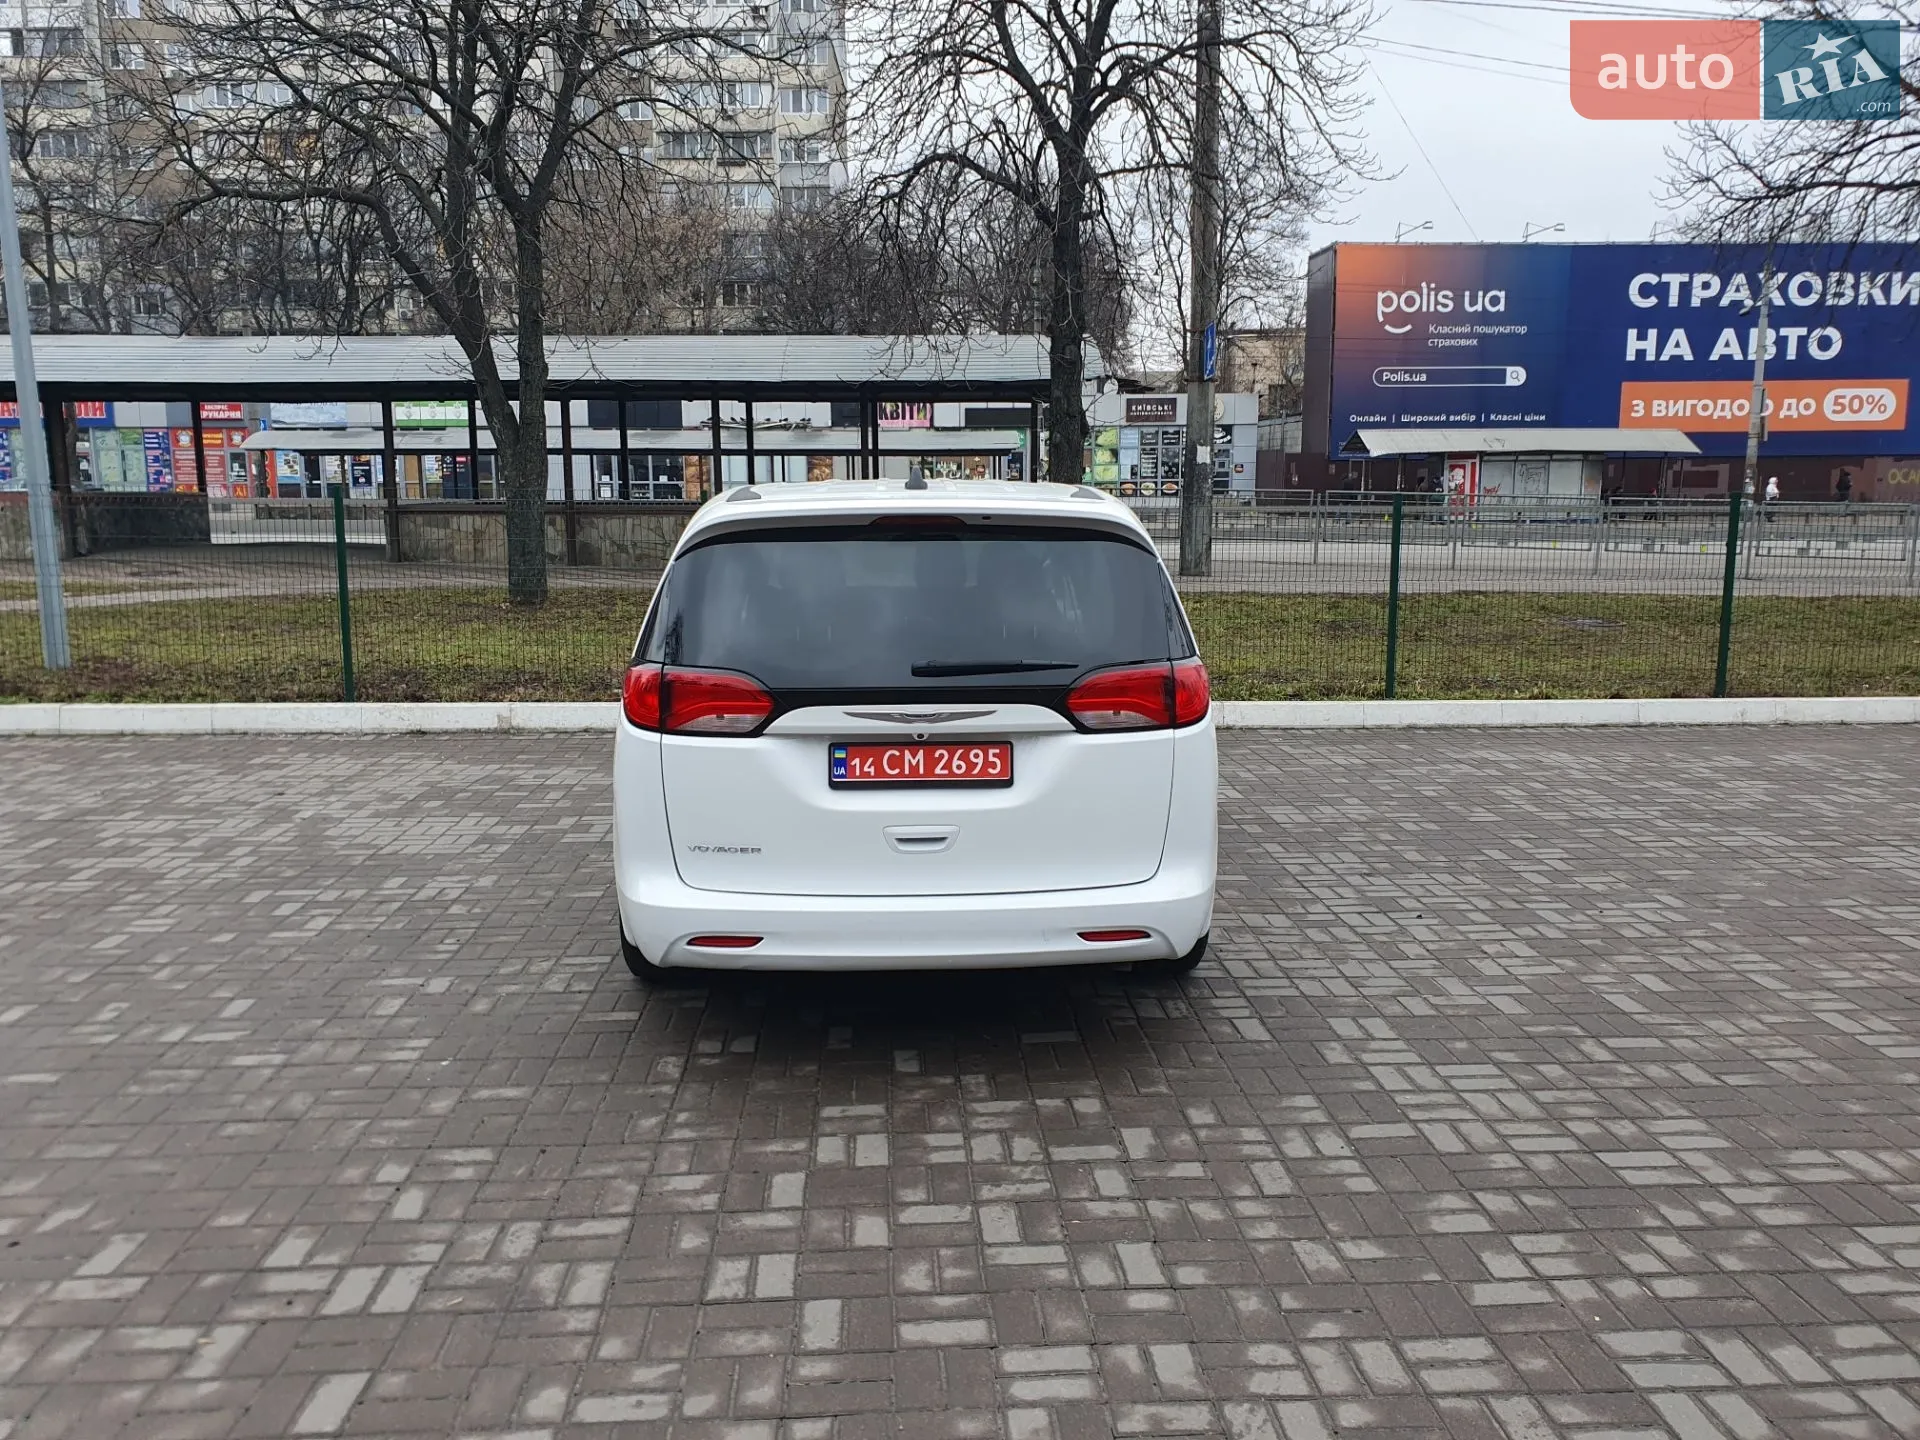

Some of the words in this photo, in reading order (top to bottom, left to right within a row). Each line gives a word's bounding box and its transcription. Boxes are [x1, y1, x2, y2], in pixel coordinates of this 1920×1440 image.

[1628, 271, 1920, 308] СТРАХОВКИ
[1376, 281, 1454, 322] polis
[1464, 290, 1506, 312] ua
[1428, 324, 1471, 334] Класний
[1473, 325, 1527, 335] пошукатор
[1428, 338, 1478, 348] страхових
[1626, 328, 1694, 361] НА
[1709, 327, 1843, 361] АВТО
[1382, 371, 1427, 382] Polis.ua
[1131, 403, 1172, 411] КИЇВСЬКІ
[1779, 398, 1816, 419] ДО
[1831, 394, 1888, 415] 50%
[201, 410, 241, 419] РУКАРНЯ
[1349, 414, 1387, 422] Онлайн
[1401, 413, 1446, 422] Широкий
[1449, 413, 1476, 422] вибір
[1490, 413, 1521, 422] Класні
[1525, 413, 1546, 422] ціни
[833, 766, 846, 775] UA
[850, 757, 875, 776] 14
[882, 749, 924, 775] CM
[934, 748, 1002, 775] 2695
[687, 845, 762, 854] VOYAGER
